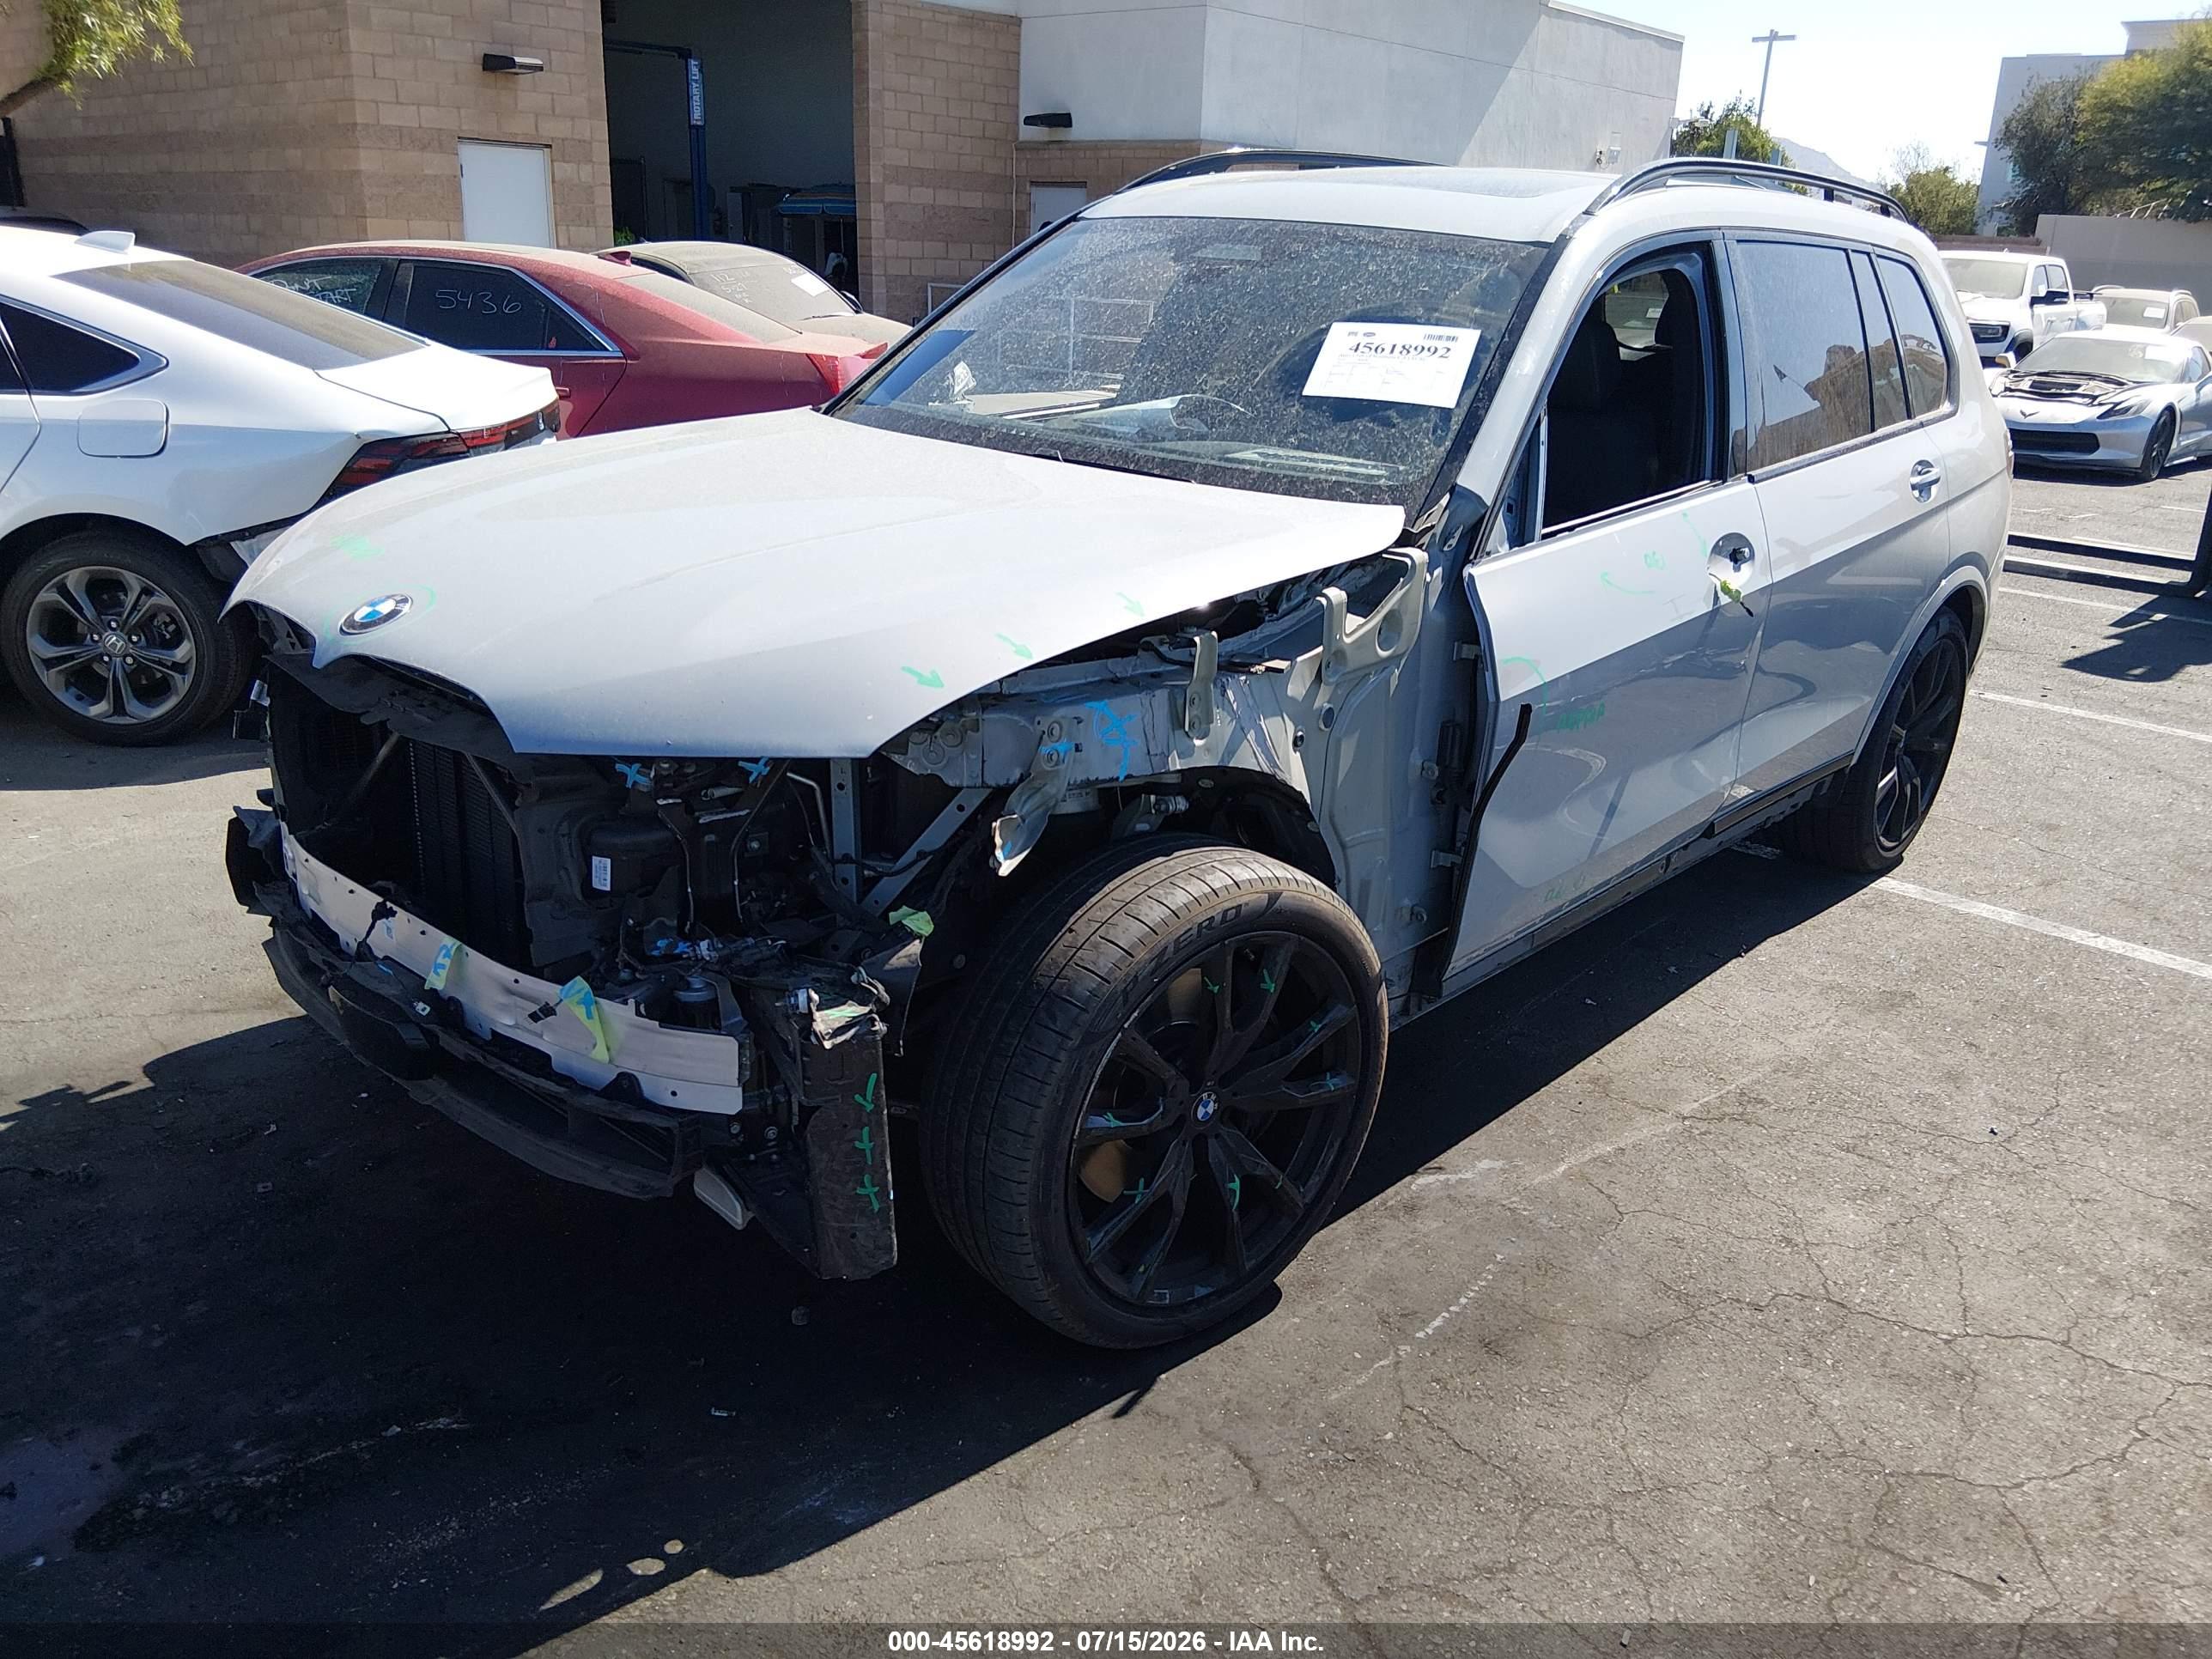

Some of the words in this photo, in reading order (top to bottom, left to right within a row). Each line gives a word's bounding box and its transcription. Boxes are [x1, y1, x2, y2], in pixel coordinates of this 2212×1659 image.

[692, 82, 702, 119] ROTARY
[307, 288, 358, 304] TART
[434, 289, 523, 314] 5436
[1348, 341, 1452, 359] 45618992
